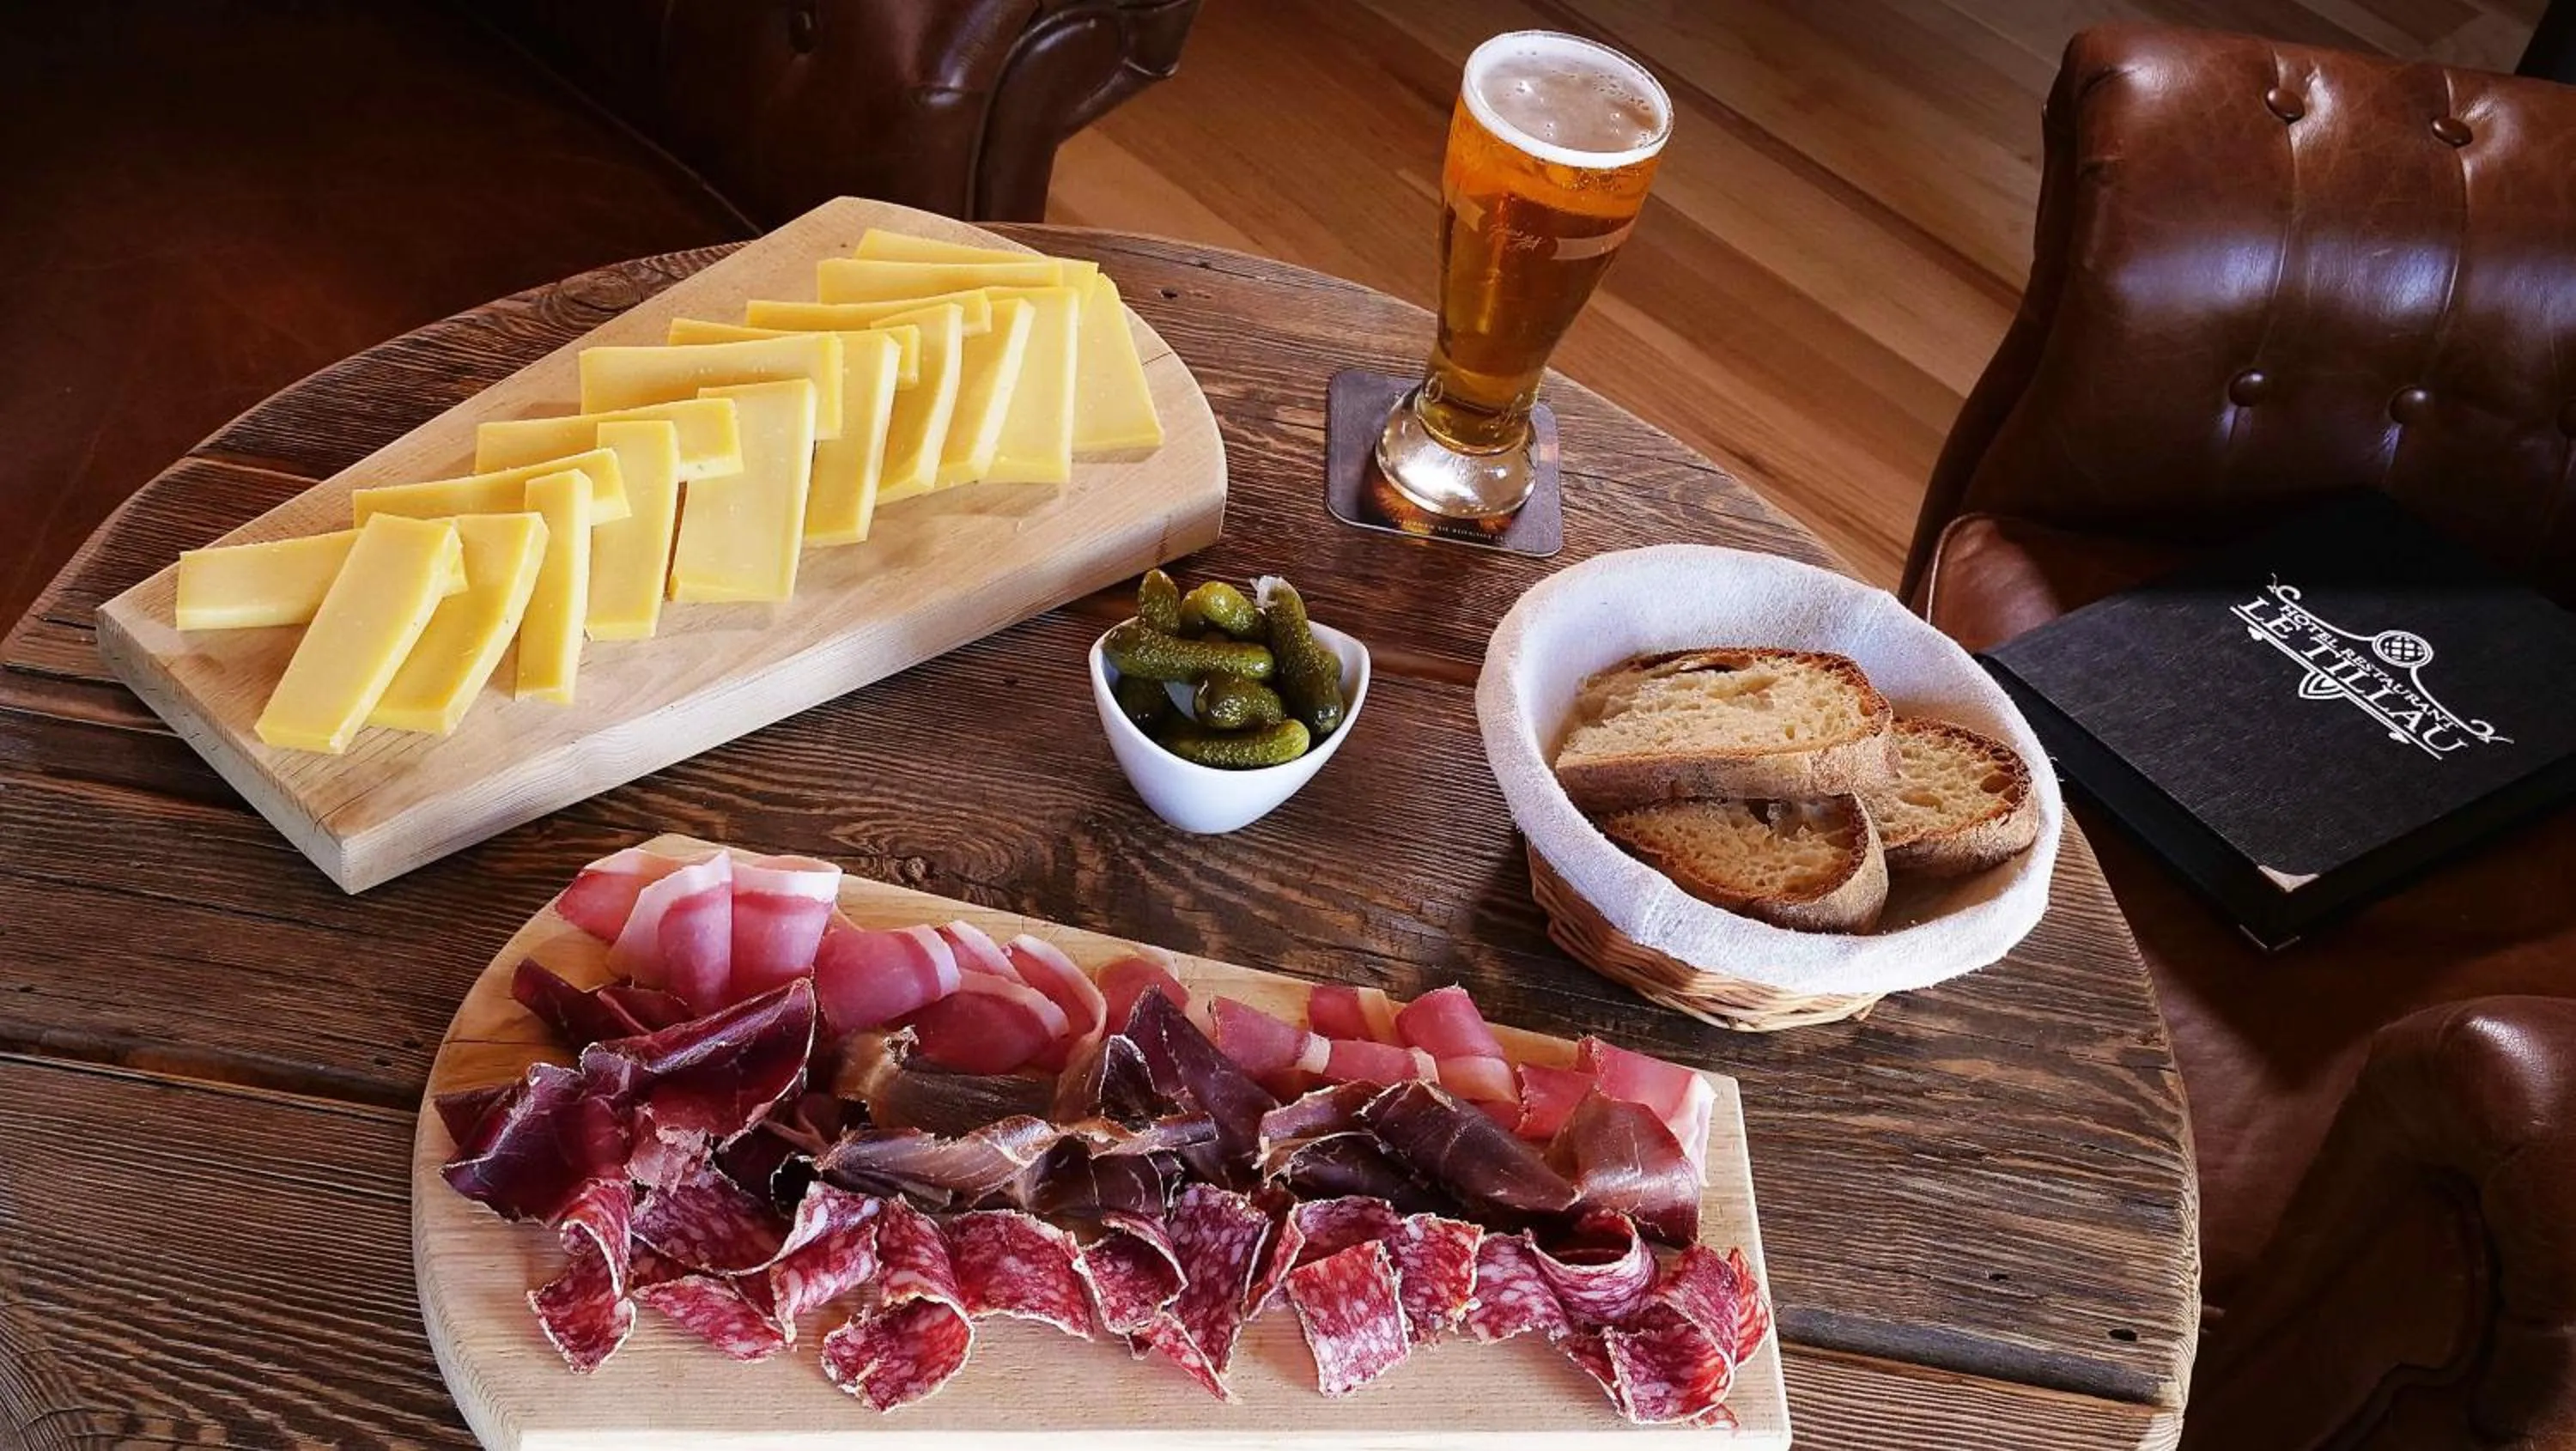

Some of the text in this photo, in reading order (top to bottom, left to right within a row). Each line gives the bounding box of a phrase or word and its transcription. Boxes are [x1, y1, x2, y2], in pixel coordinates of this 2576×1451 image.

[2237, 596, 2469, 751] LE TILLAU
[2278, 604, 2459, 729] HOTEL RESTAURANT
